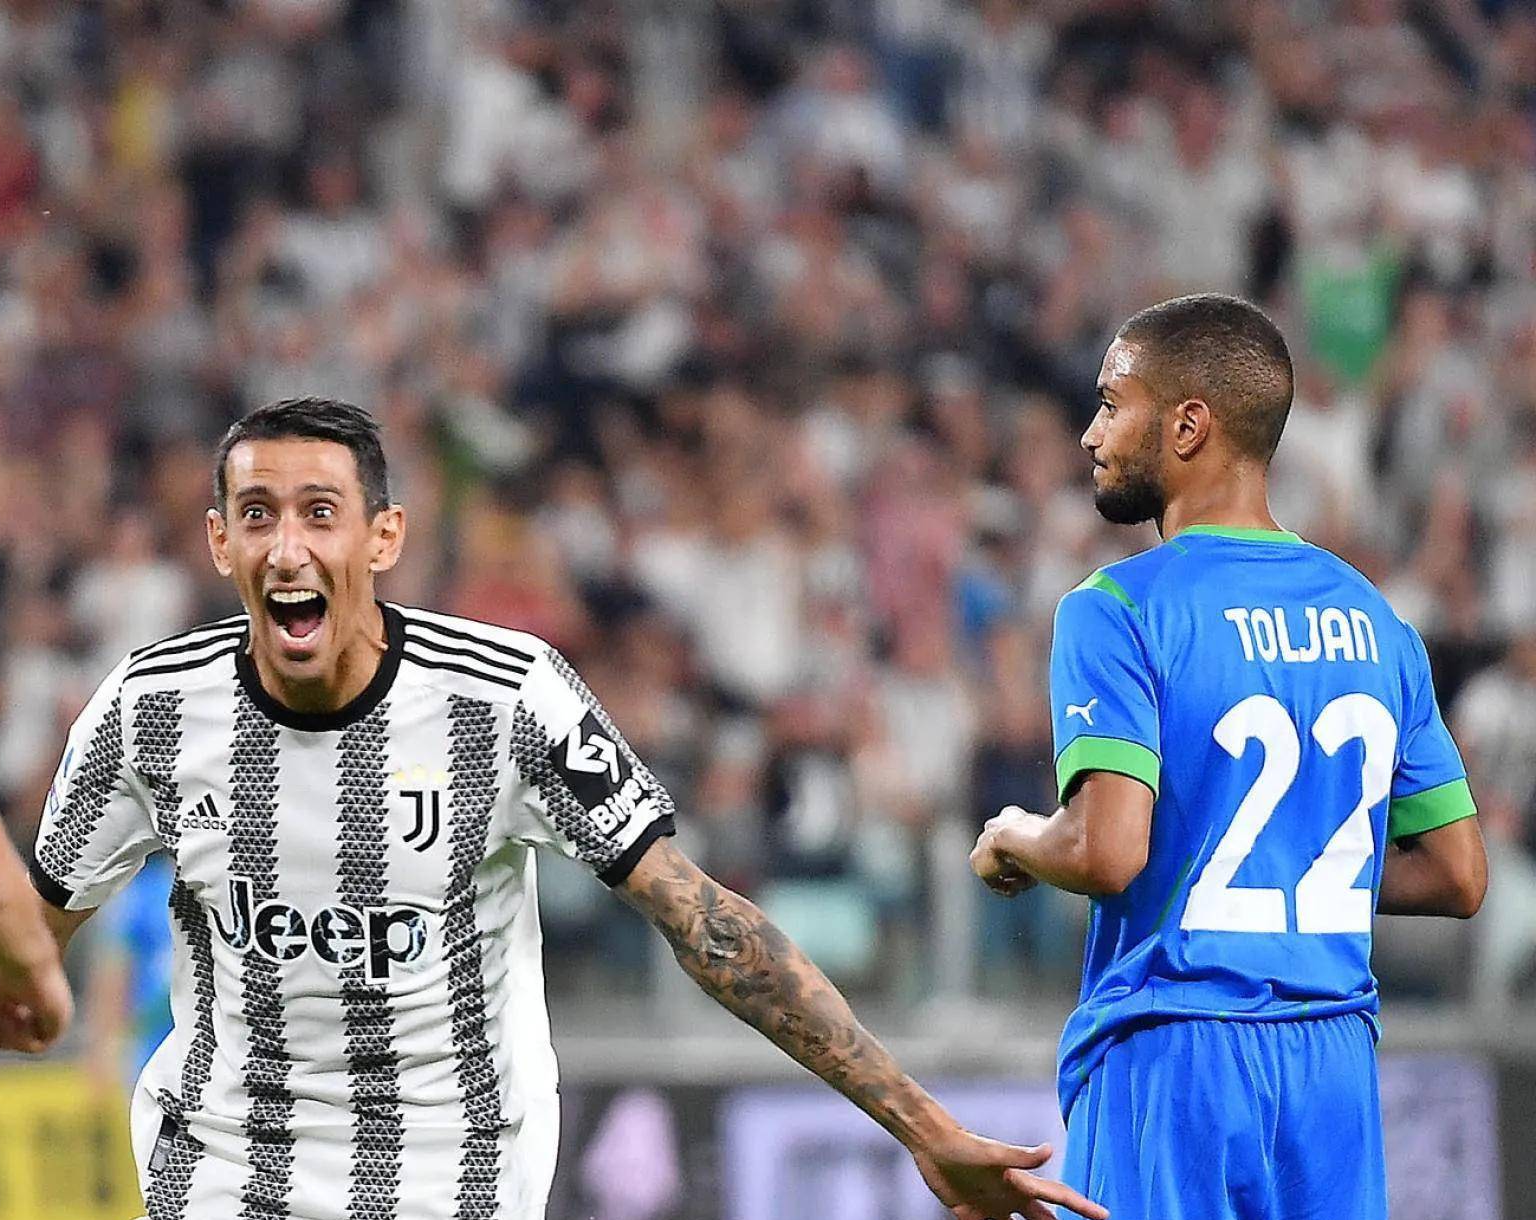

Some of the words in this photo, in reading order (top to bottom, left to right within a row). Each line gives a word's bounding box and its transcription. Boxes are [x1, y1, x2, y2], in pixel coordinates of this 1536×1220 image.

[1223, 607, 1380, 663] TOLJAN
[181, 816, 227, 831] adidas
[1183, 693, 1398, 934] 22
[208, 875, 429, 984] Jeep
